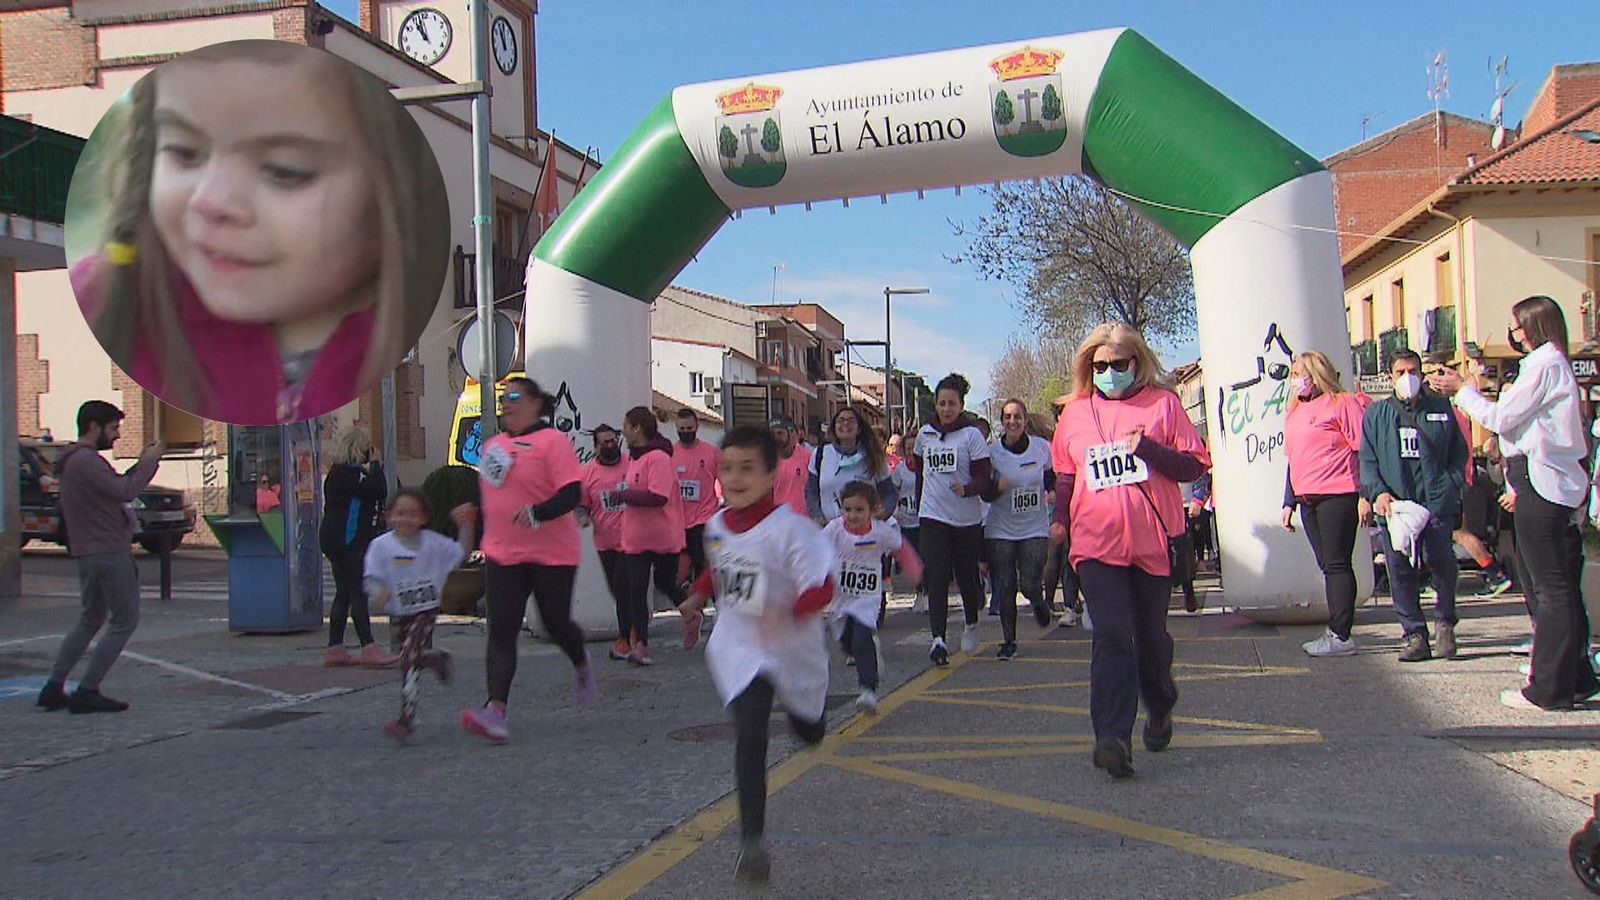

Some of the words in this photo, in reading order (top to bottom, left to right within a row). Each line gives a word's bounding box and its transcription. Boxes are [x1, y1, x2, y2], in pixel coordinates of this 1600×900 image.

[806, 87, 936, 118] Ayuntamiento
[941, 81, 964, 98] de
[808, 121, 844, 156] El
[856, 110, 966, 150] Álamo
[1227, 392, 1254, 434] El
[926, 453, 955, 468] 1049
[1089, 453, 1137, 480] 1104
[1013, 493, 1038, 509] 1050
[840, 571, 878, 591] 1039
